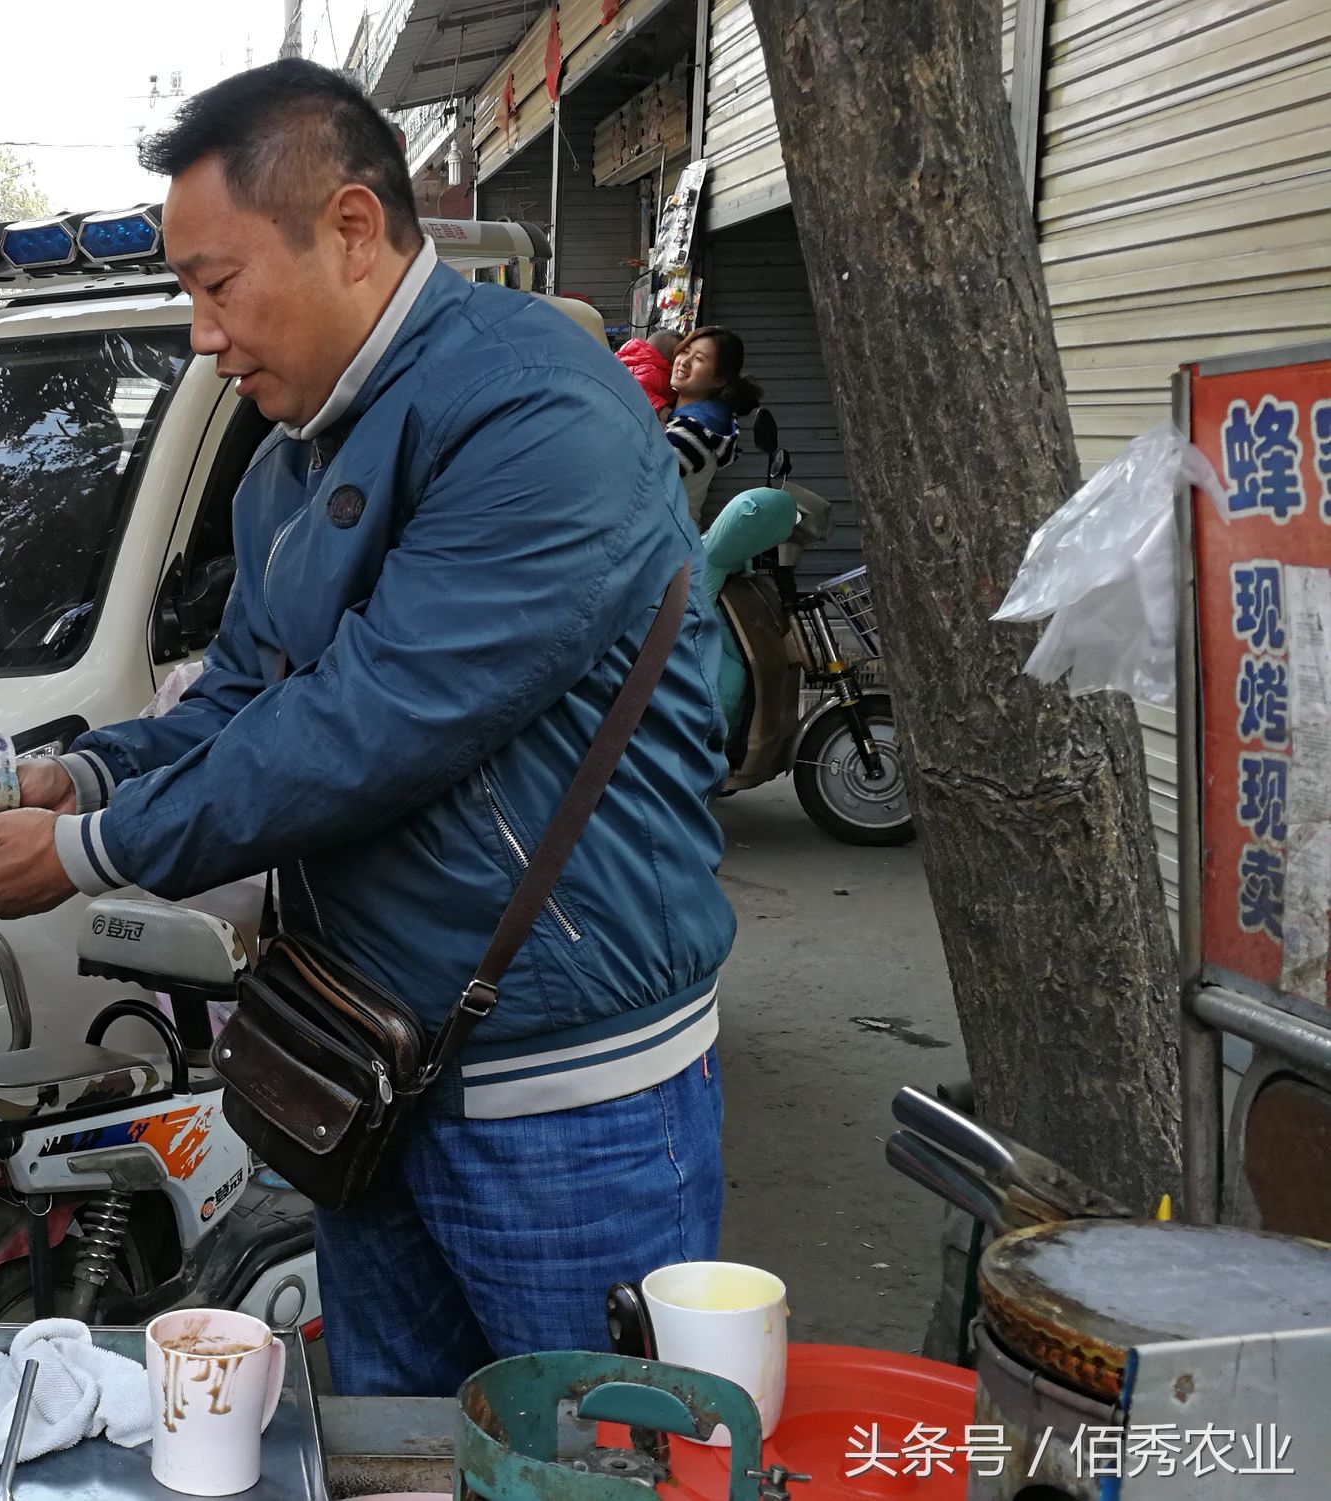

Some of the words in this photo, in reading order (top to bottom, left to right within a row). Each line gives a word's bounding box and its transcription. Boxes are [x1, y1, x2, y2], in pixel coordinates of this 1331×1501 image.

[1232, 562, 1290, 943] 现烤现卖
[106, 917, 145, 941] 登冠
